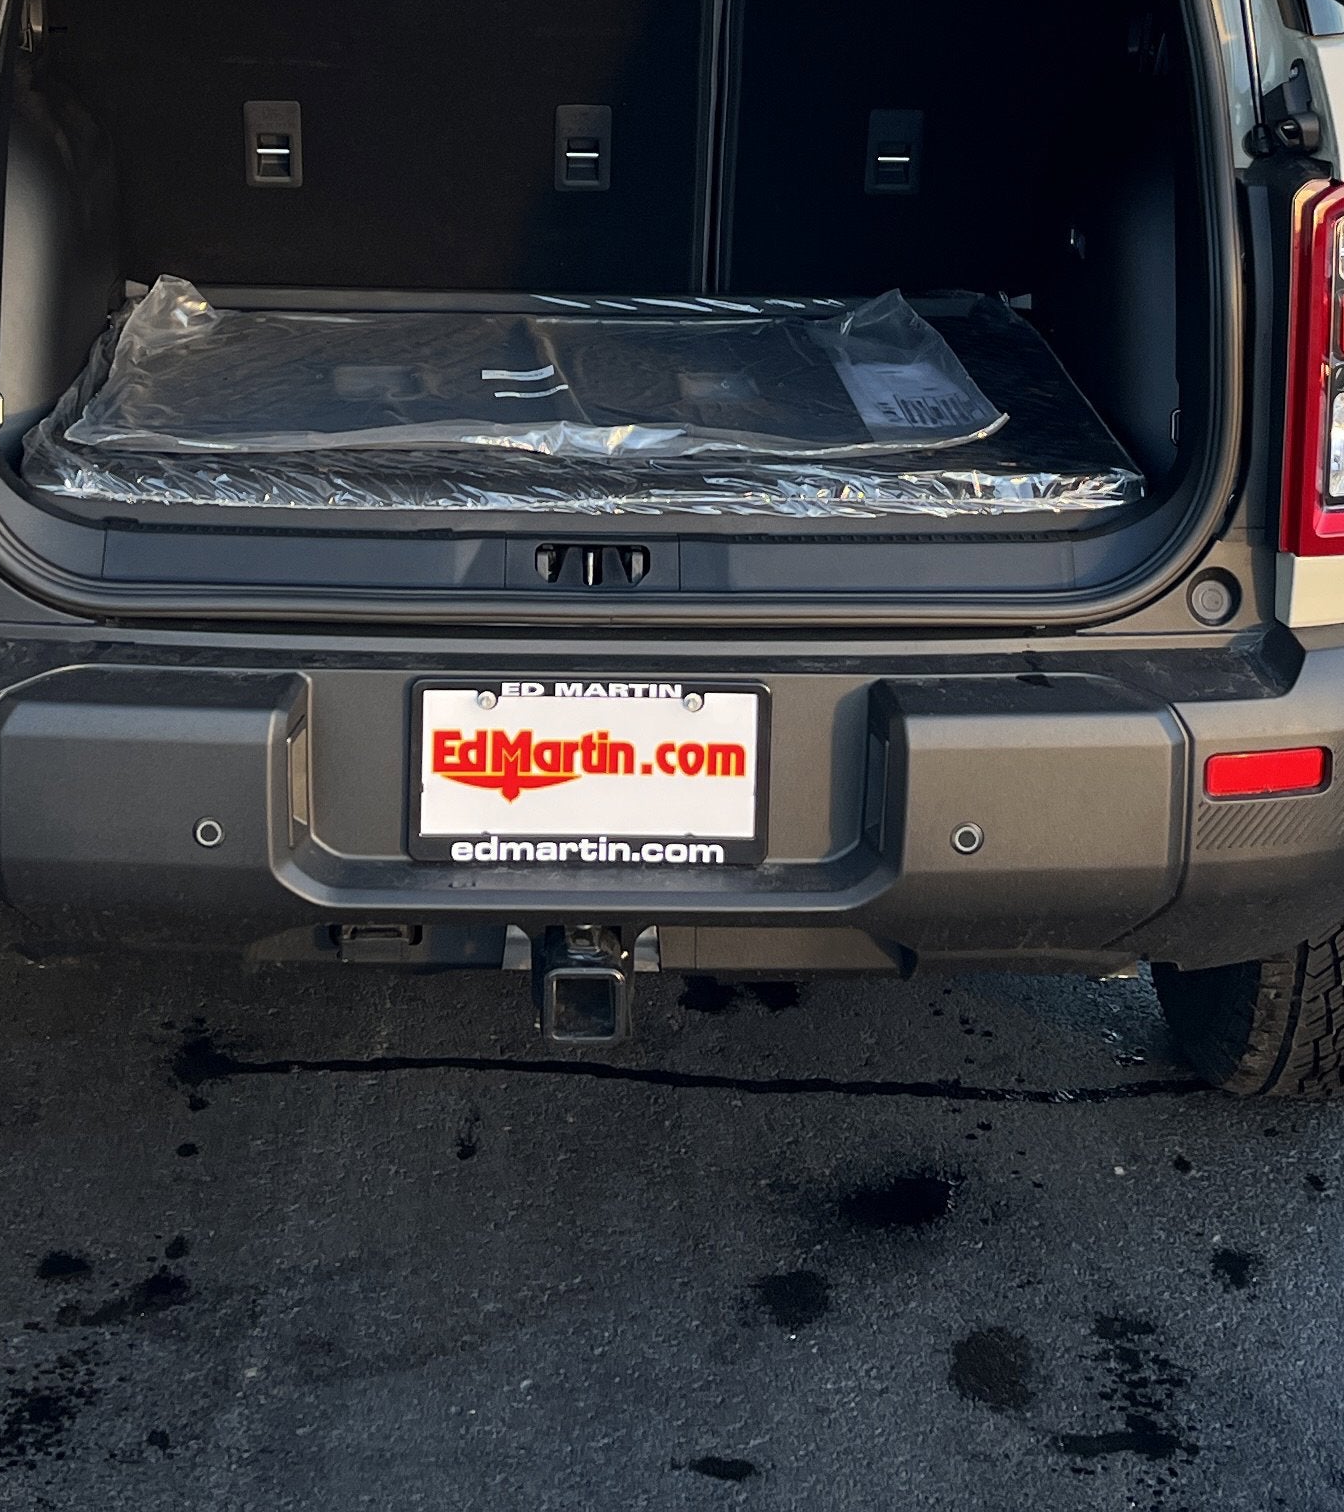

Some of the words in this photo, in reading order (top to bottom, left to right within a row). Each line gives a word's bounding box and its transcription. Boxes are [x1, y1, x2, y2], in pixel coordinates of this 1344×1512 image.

[501, 682, 545, 697] ED
[555, 682, 683, 698] MARTIN
[431, 729, 747, 778] EdMartin.com
[451, 836, 725, 864] edmartin.com
